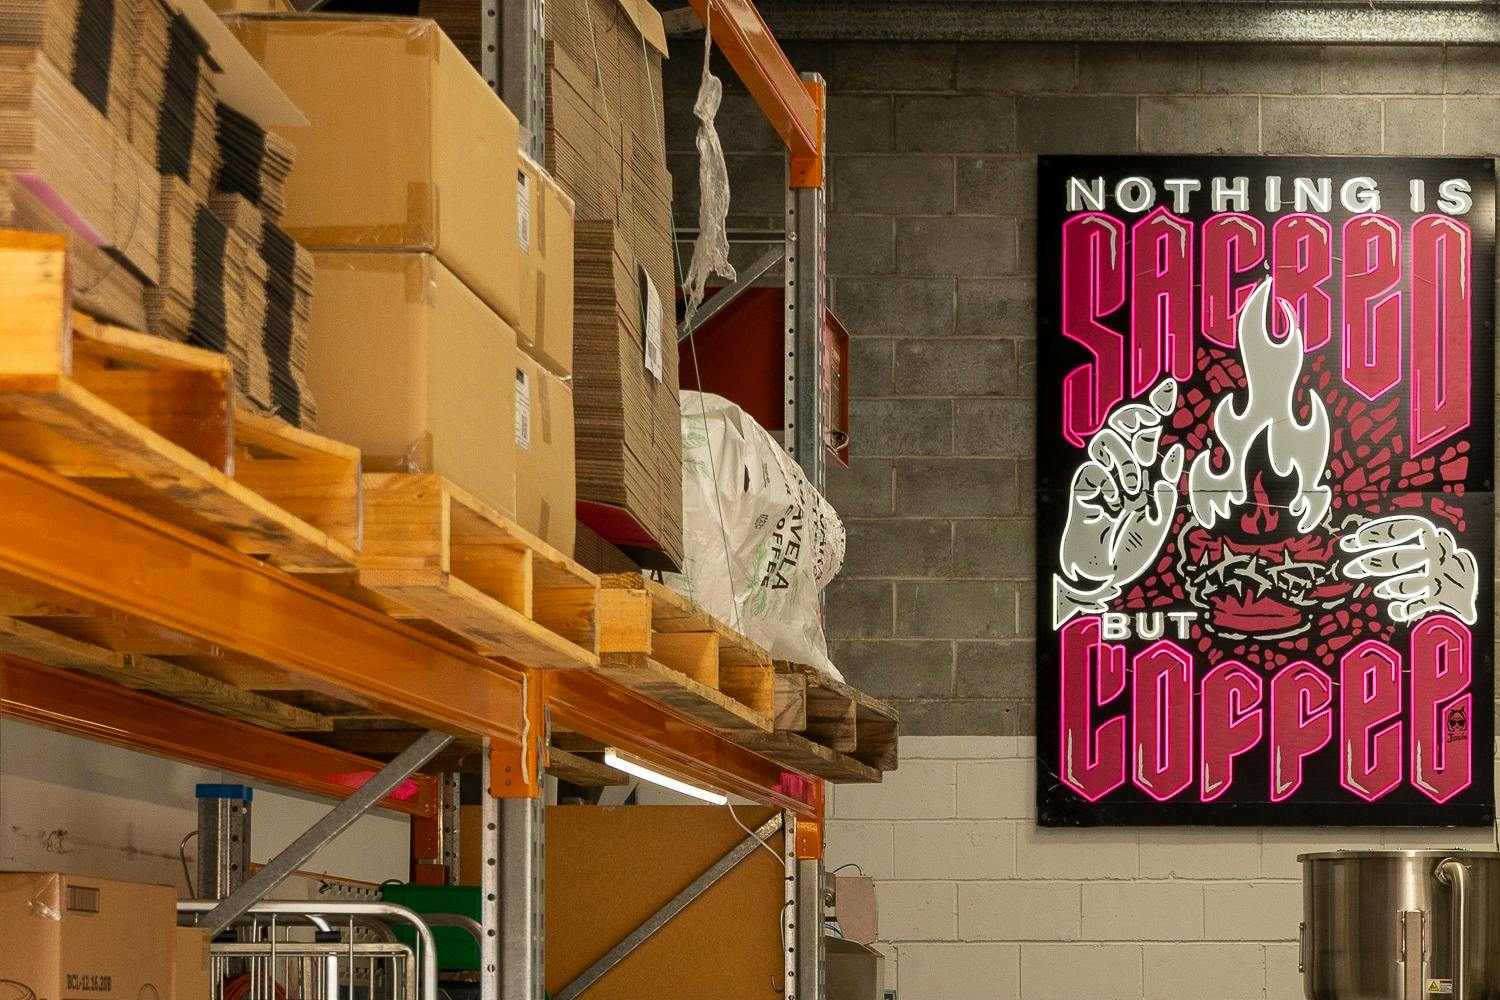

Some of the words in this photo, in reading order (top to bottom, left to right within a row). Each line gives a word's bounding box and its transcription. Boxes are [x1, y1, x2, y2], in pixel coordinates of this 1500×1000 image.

[1066, 176, 1379, 213] NOTHING
[1410, 178, 1473, 214] IS
[1062, 206, 1473, 458] SACRED
[761, 504, 794, 588] COFFEE
[1102, 612, 1198, 640] BUT
[1060, 615, 1472, 803] COFFEE
